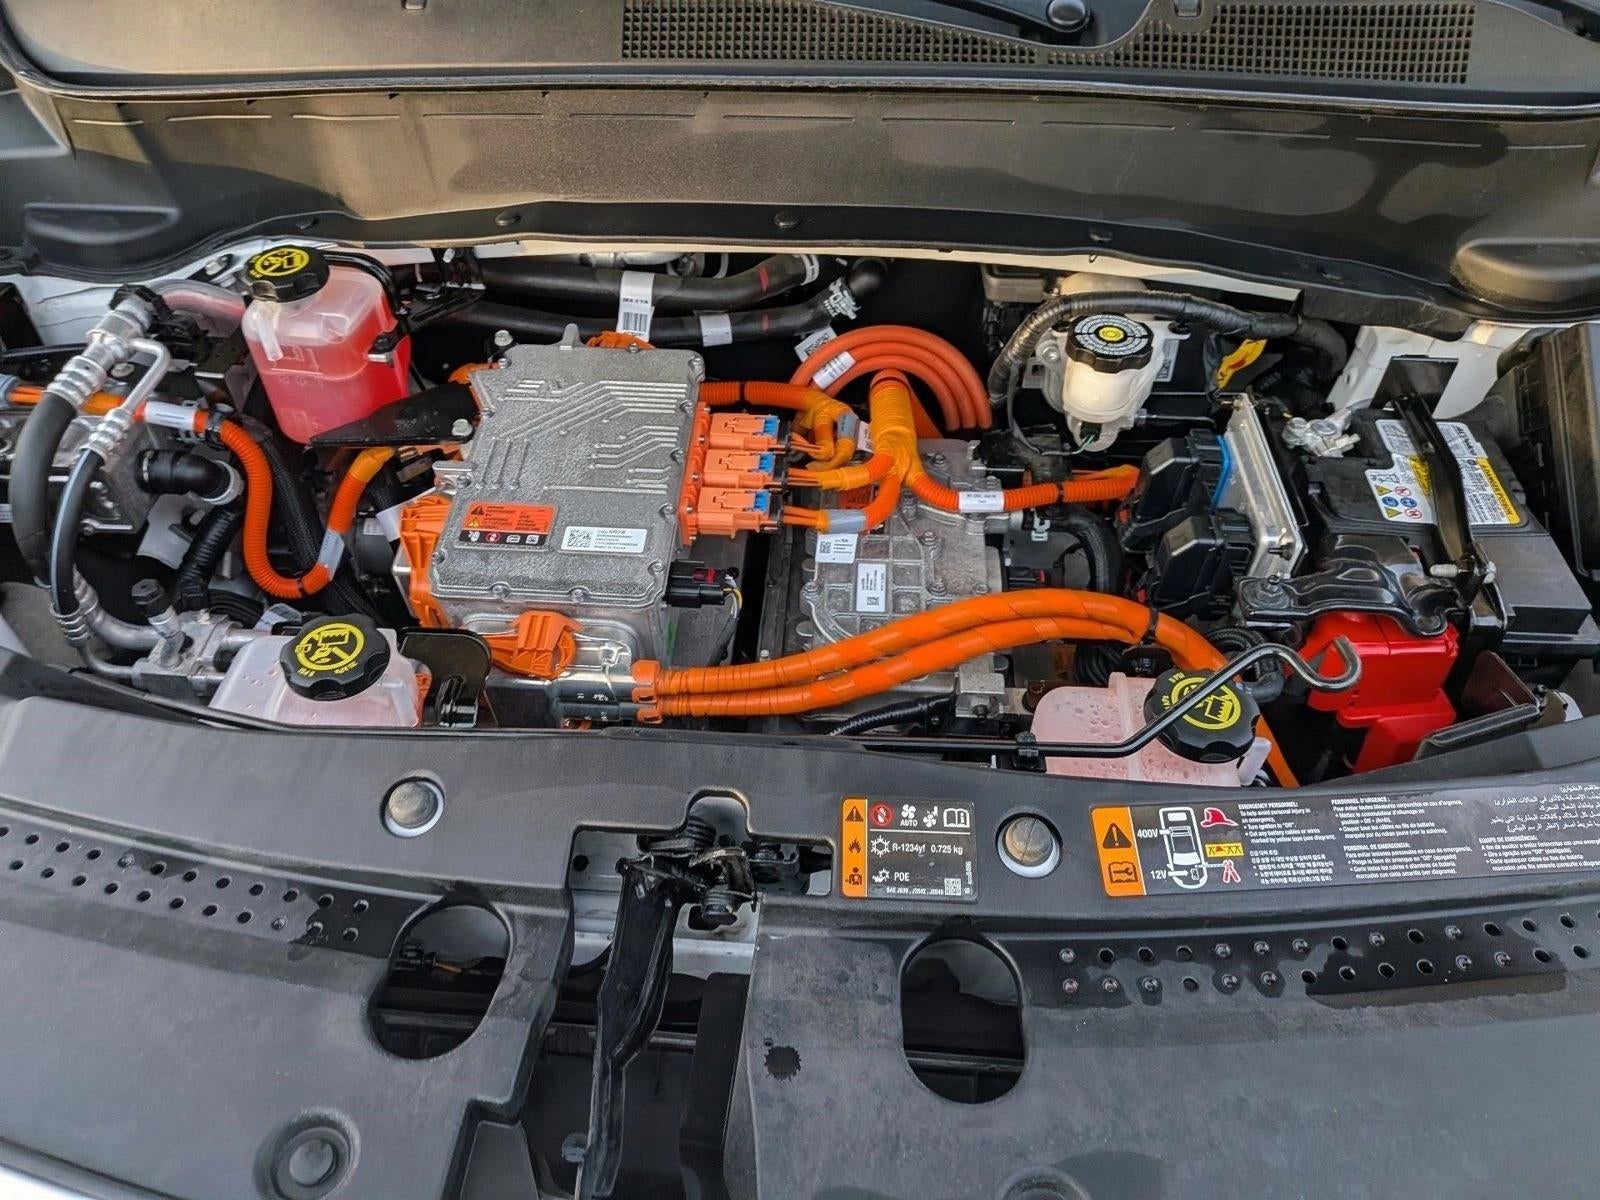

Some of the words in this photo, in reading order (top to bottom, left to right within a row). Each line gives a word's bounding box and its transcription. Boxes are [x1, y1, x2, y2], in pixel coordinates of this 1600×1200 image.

[1137, 829, 1158, 839] 400V
[892, 843, 925, 854] R-1234yf
[931, 845, 952, 853] 0.725
[953, 845, 963, 855] kg
[894, 872, 910, 881] POE
[1151, 870, 1167, 880] 12V
